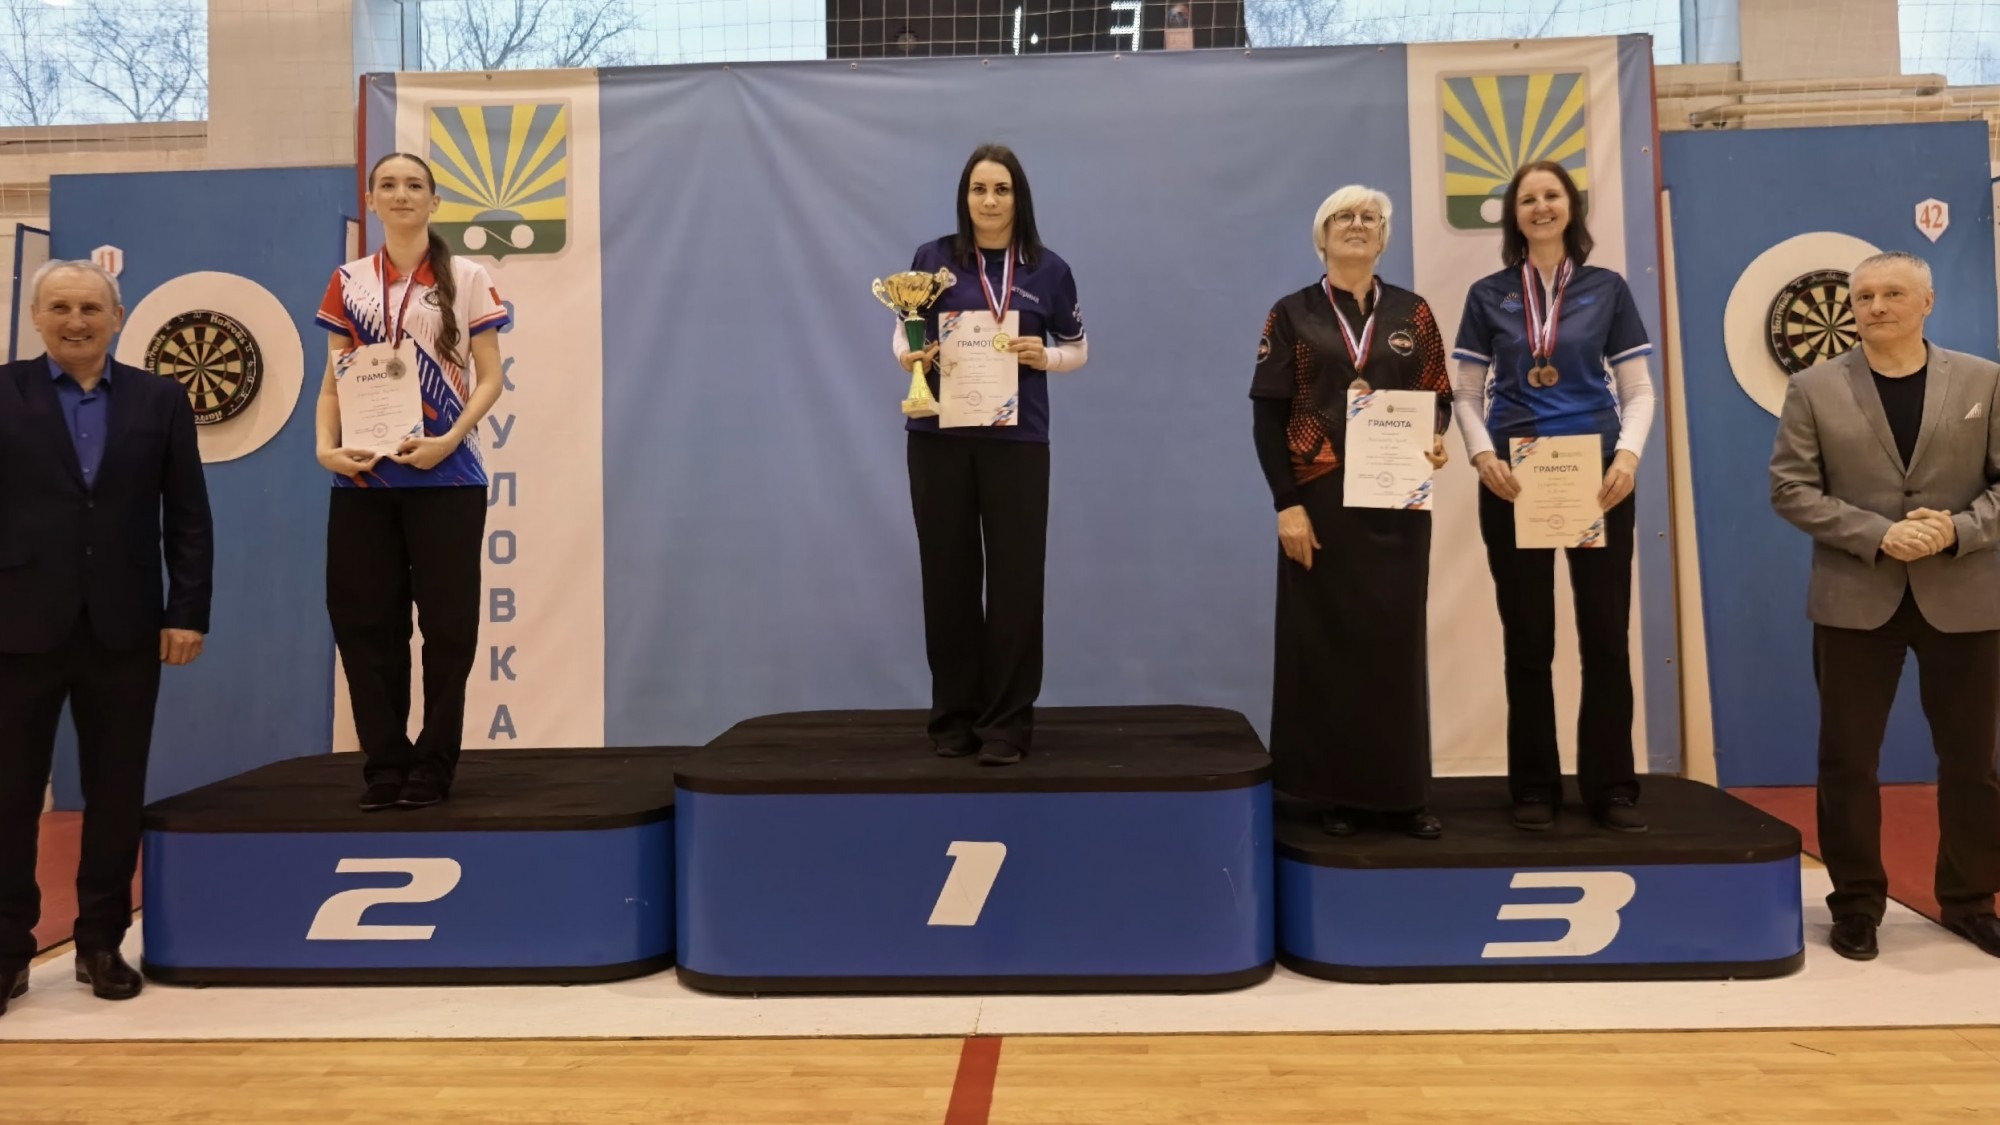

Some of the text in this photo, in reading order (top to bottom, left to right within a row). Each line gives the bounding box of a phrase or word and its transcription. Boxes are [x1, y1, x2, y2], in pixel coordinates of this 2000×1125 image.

[1920, 204, 1943, 229] 42
[957, 340, 992, 348] ГРАМОТ
[356, 372, 388, 382] ГРАМО
[1367, 419, 1412, 428] ГРАМОТА
[1533, 465, 1579, 473] ГРАМОТА
[927, 841, 1007, 926] 1
[306, 858, 462, 940] 2
[1481, 871, 1637, 959] 3
